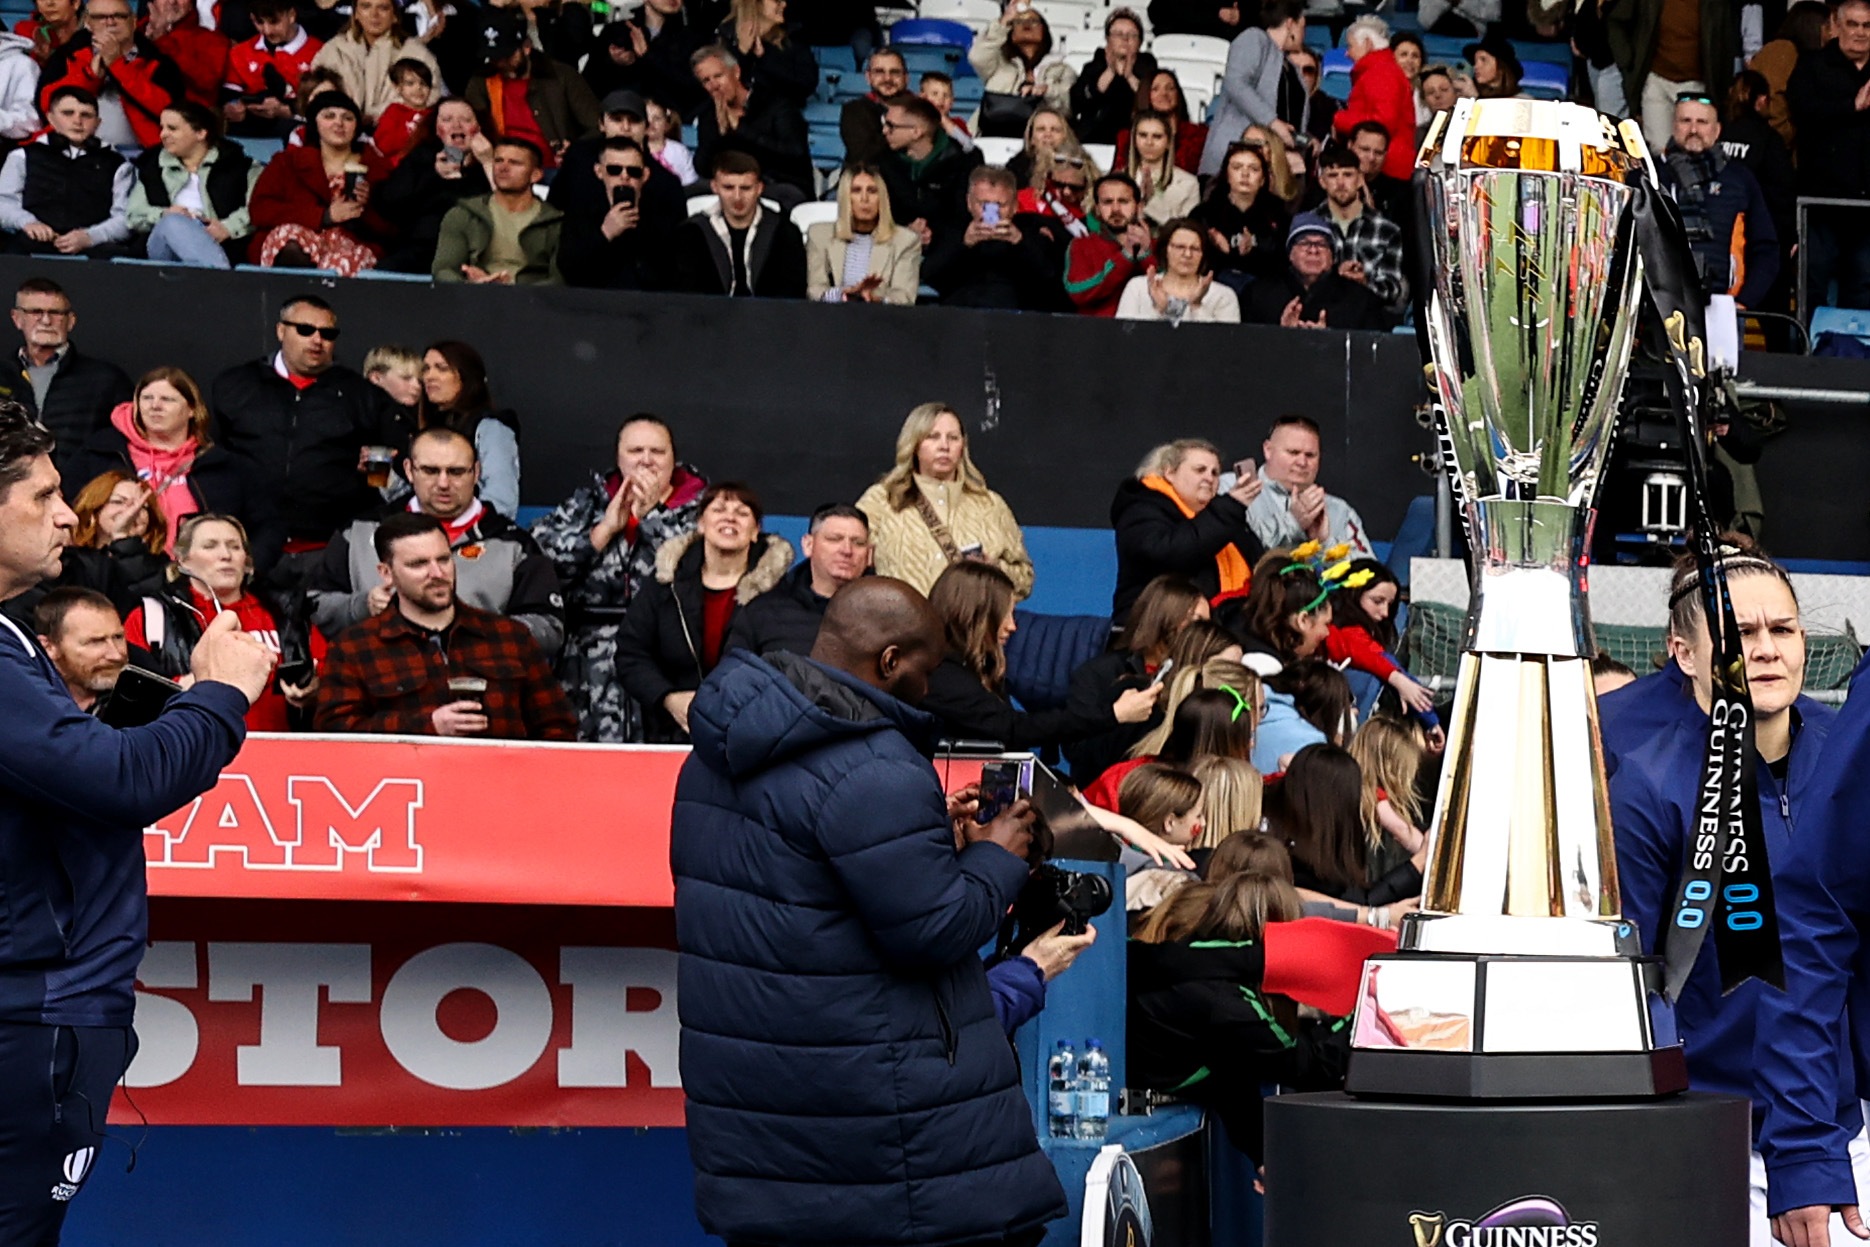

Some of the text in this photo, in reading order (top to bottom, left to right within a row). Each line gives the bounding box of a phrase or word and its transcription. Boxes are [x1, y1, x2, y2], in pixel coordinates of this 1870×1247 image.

[1721, 141, 1750, 159] RITY
[143, 773, 424, 873] AM
[1675, 698, 1730, 929] GUINNESS 0.0
[1723, 883, 1764, 931] 0.0
